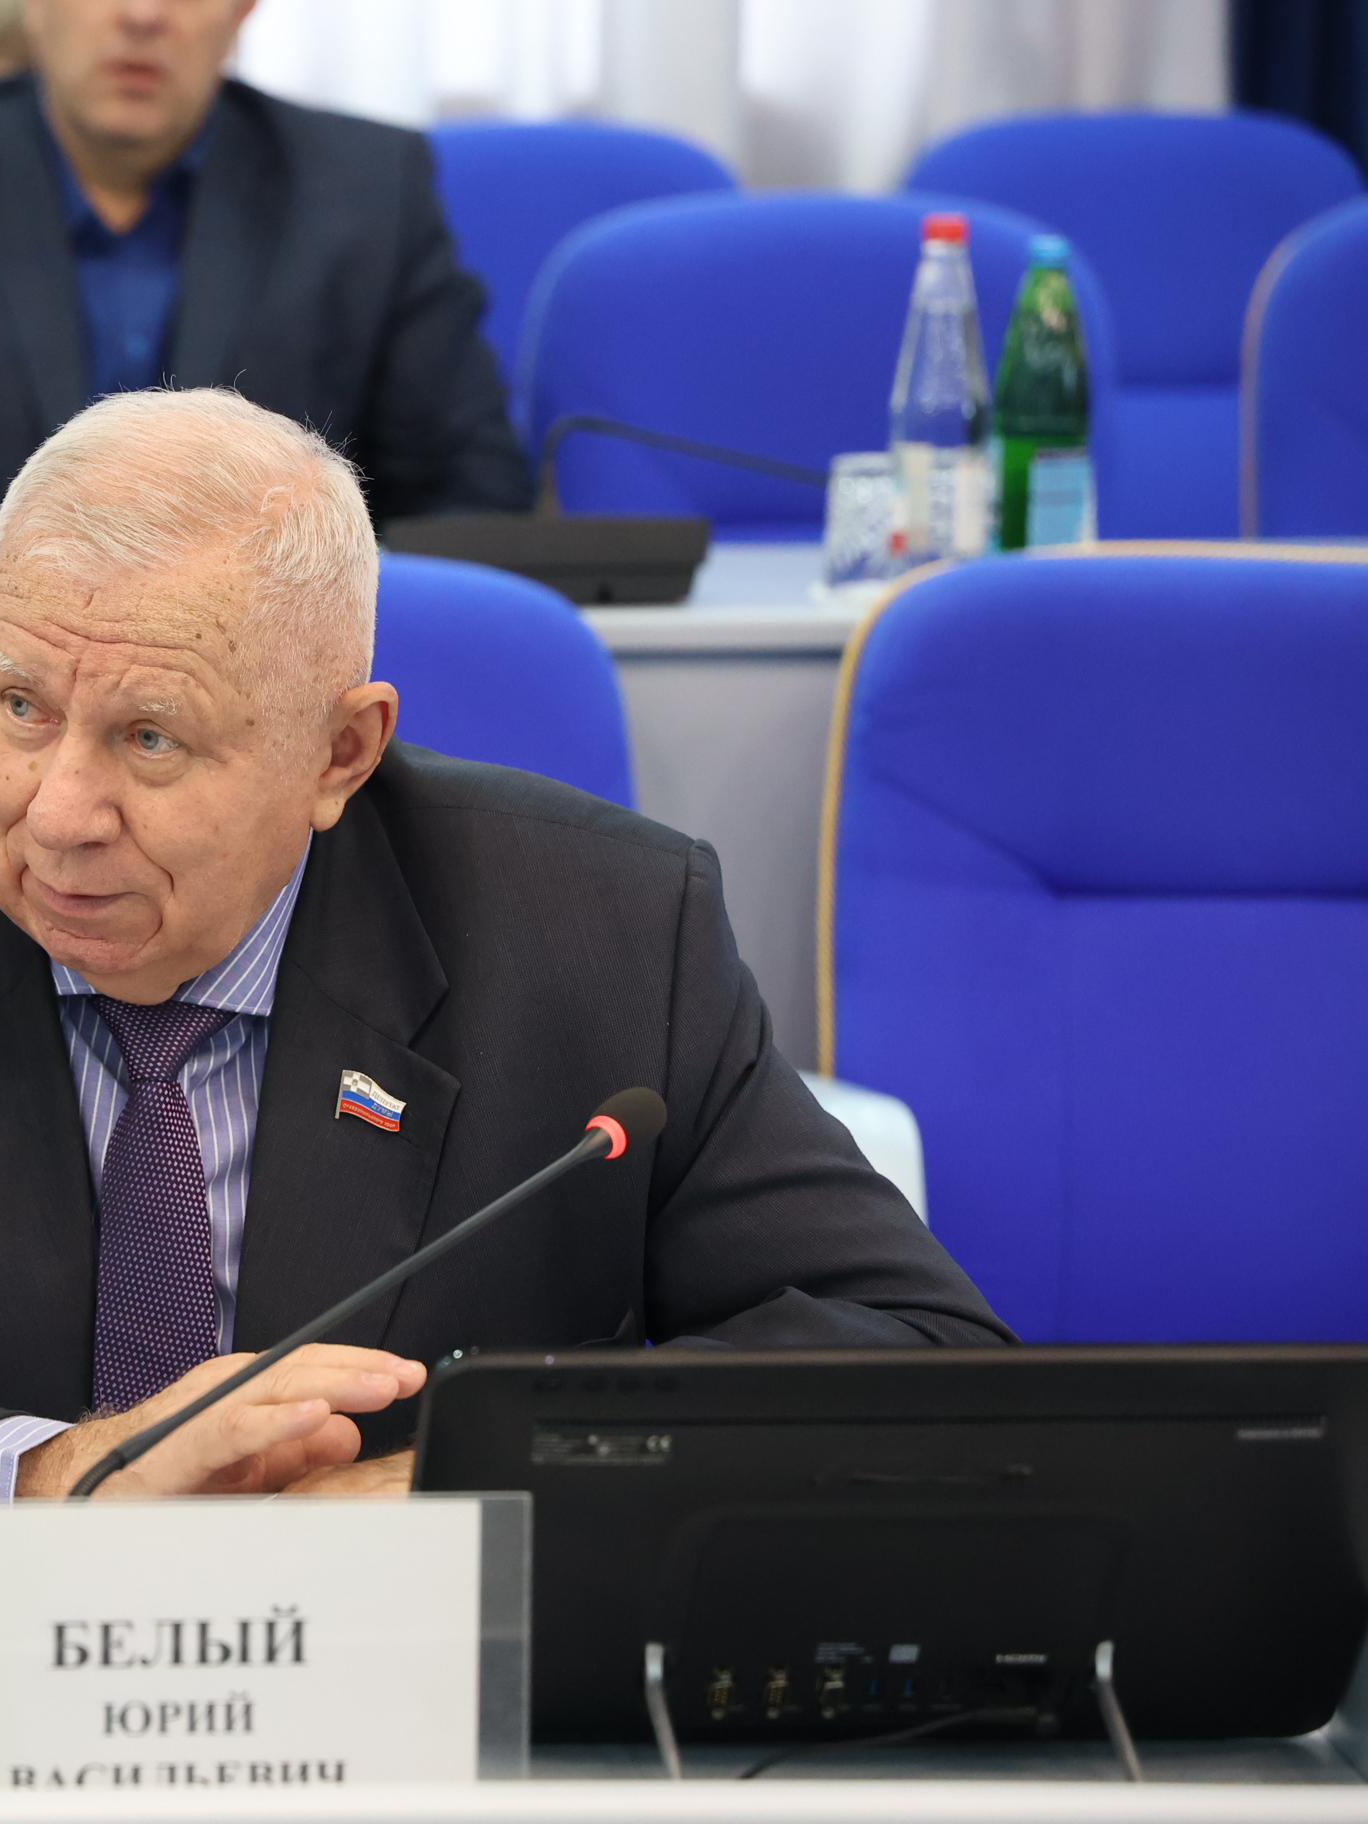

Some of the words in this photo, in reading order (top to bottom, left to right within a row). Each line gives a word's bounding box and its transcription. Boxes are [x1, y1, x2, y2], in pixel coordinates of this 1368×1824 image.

[371, 1090, 401, 1111] ДЕПУТАТ
[371, 1102, 394, 1117] ДУМЫ
[51, 1605, 308, 1669] БЕЛЫЙ
[104, 1691, 254, 1735] ЮРИЙ
